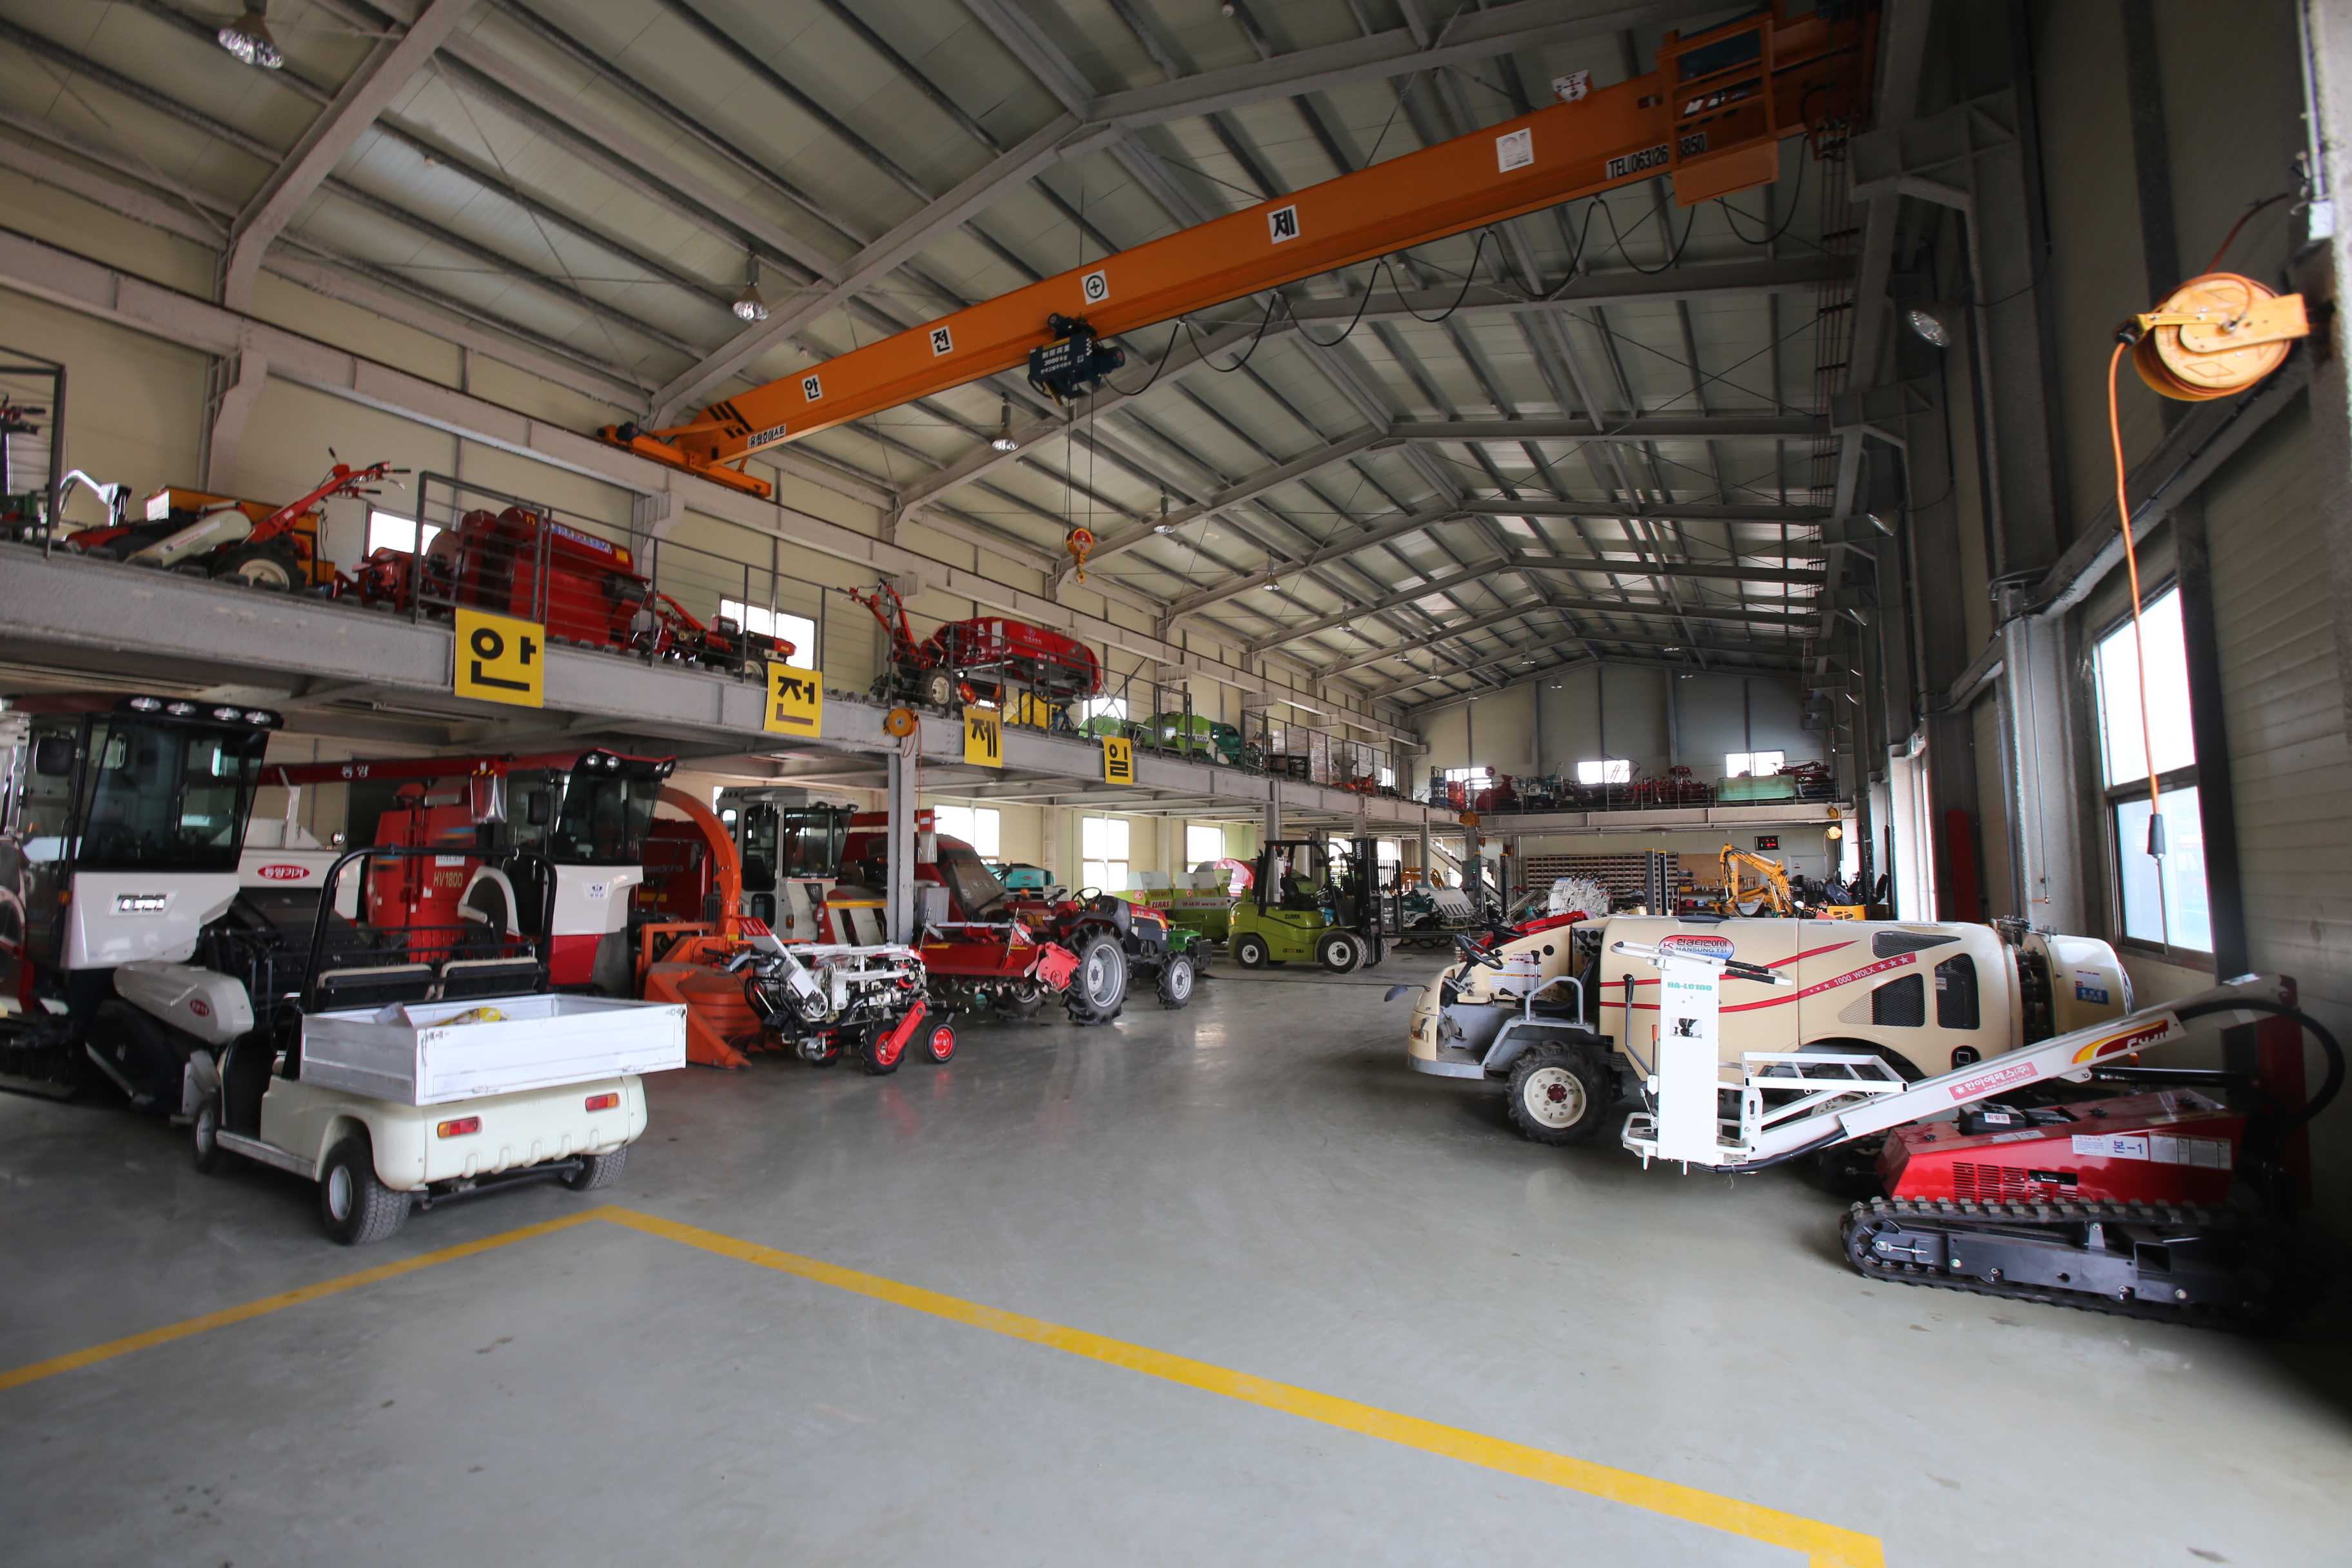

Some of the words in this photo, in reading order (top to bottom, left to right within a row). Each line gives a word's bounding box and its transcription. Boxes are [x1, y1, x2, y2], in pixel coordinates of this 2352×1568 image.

[805, 378, 819, 400] 안
[933, 329, 950, 353] 전
[1273, 209, 1296, 237] 제
[471, 628, 537, 693] 안
[776, 676, 814, 727] 전
[970, 718, 997, 758] 제
[1109, 743, 1129, 777] 일
[433, 872, 464, 888] HV1800
[1834, 975, 1852, 986] 1000
[1852, 966, 1876, 979] WDLX
[2112, 1140, 2142, 1154] 본-1
